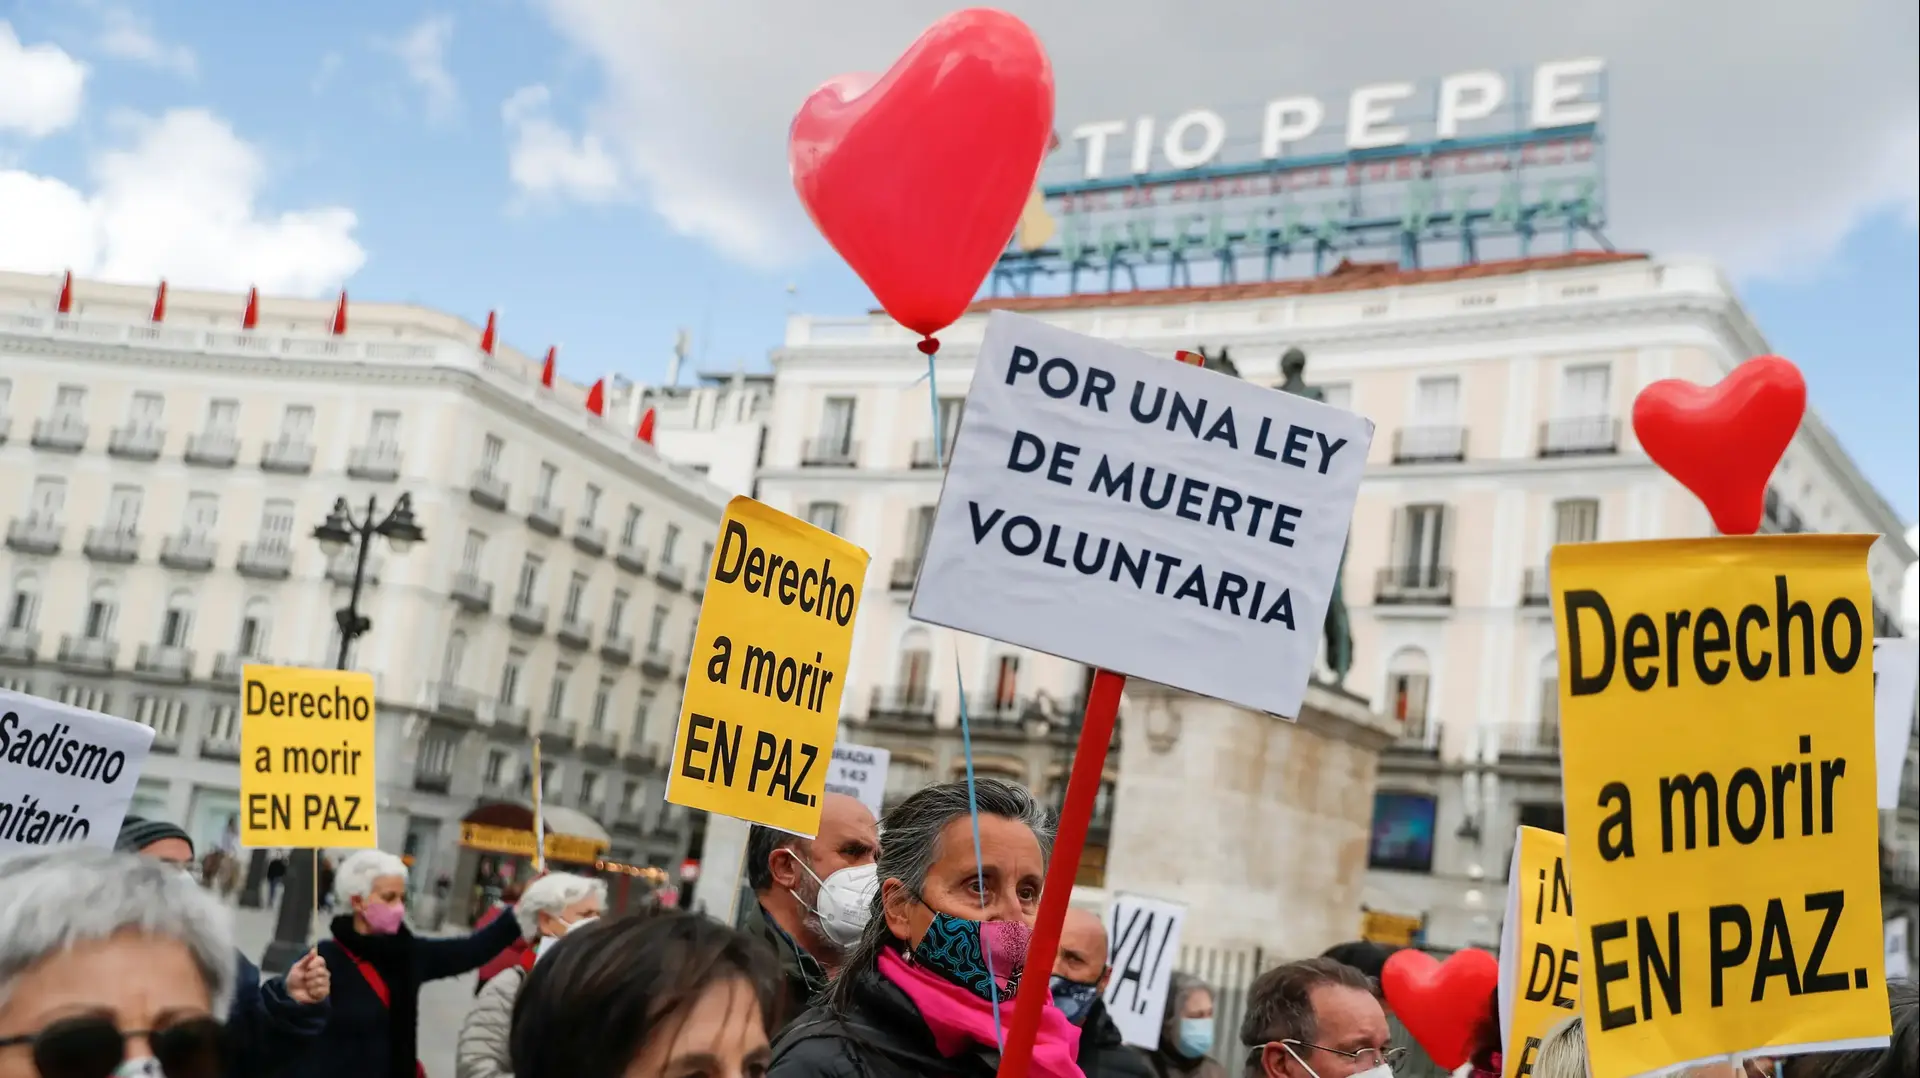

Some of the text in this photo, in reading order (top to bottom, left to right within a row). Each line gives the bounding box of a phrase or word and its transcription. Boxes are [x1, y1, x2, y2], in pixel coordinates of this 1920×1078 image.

[1073, 56, 1606, 179] TIO PEPE
[1005, 345, 1348, 475] POR UNA LEY
[1006, 430, 1303, 548] DE MUERTE
[715, 518, 855, 627] Derecho
[968, 500, 1296, 631] VOLUNTARIA
[707, 635, 834, 713] a morir
[1564, 575, 1863, 697] Derecho
[0, 711, 125, 784] Sadismo
[247, 680, 370, 722] Derecho
[249, 794, 370, 831] EN PAZ.
[255, 741, 362, 775] a morir
[681, 713, 819, 808] EN PAZ.
[1597, 734, 1846, 862] a morir
[1108, 903, 1175, 1015] YA!
[1591, 889, 1869, 1032] EN PAZ.
